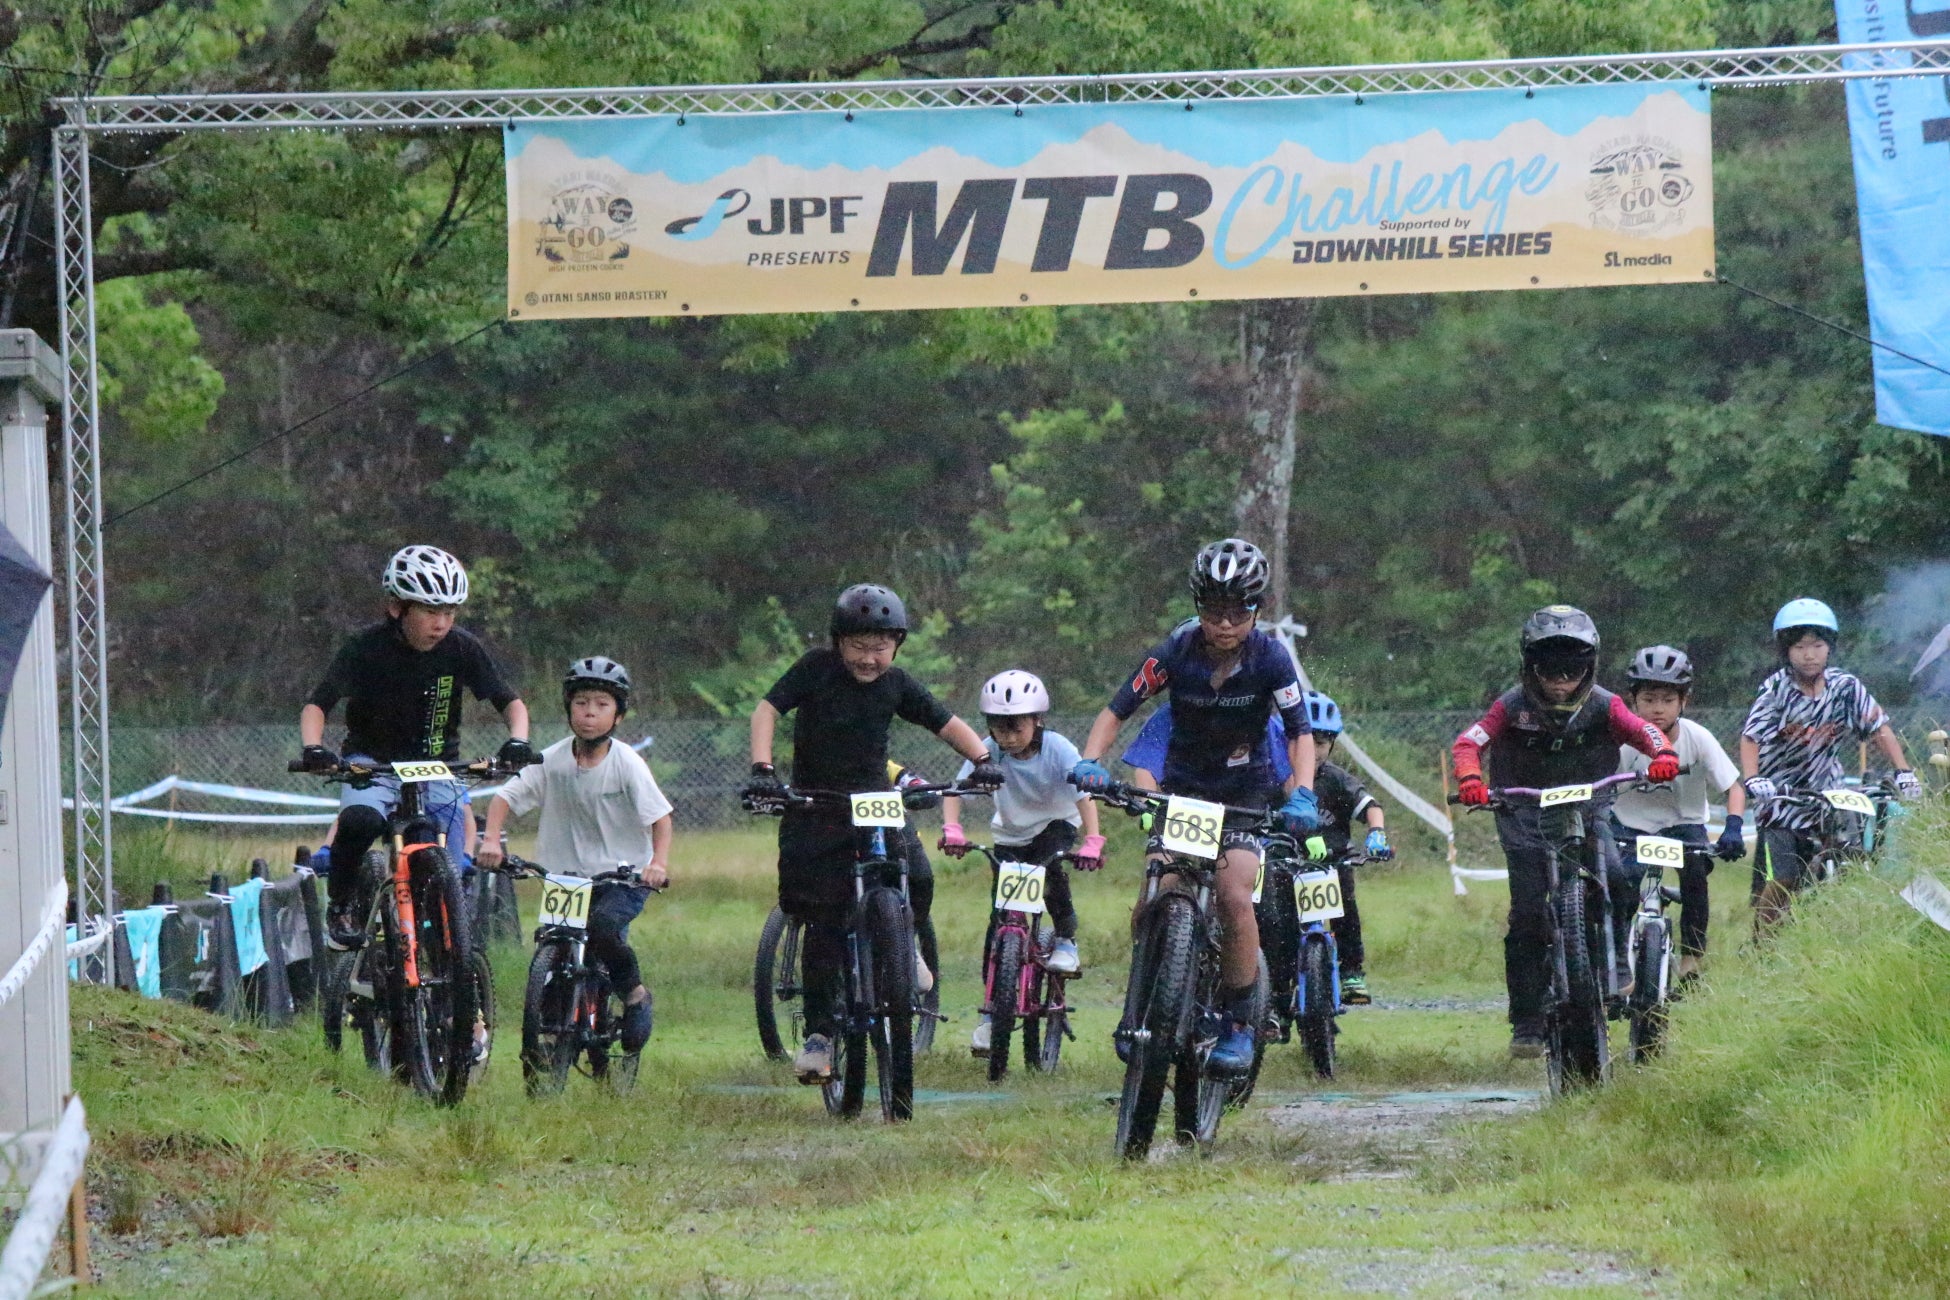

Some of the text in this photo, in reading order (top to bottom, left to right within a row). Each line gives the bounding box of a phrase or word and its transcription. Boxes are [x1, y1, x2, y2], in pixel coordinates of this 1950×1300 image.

[1874, 82, 1897, 160] Future
[1615, 152, 1657, 176] WAY
[562, 196, 608, 214] WAY
[1213, 153, 1559, 270] Challenge
[1620, 187, 1656, 212] GO
[747, 196, 863, 235] JPF
[865, 173, 1213, 277] MTB
[1379, 217, 1471, 232] Supported by
[567, 226, 605, 248] GO
[1293, 232, 1552, 264] DOWNHILL SERIES
[747, 250, 851, 266] PRESENTS
[1604, 251, 1672, 267] SL media
[542, 289, 668, 303] OTANI SANSO ROASTERY
[399, 766, 447, 777] 680
[1545, 788, 1588, 802] 674
[855, 800, 902, 818] 688
[1167, 812, 1218, 846] 683
[1639, 843, 1680, 861] 665
[1001, 874, 1040, 903] 670
[1298, 882, 1340, 912] 660
[545, 888, 584, 917] 671
